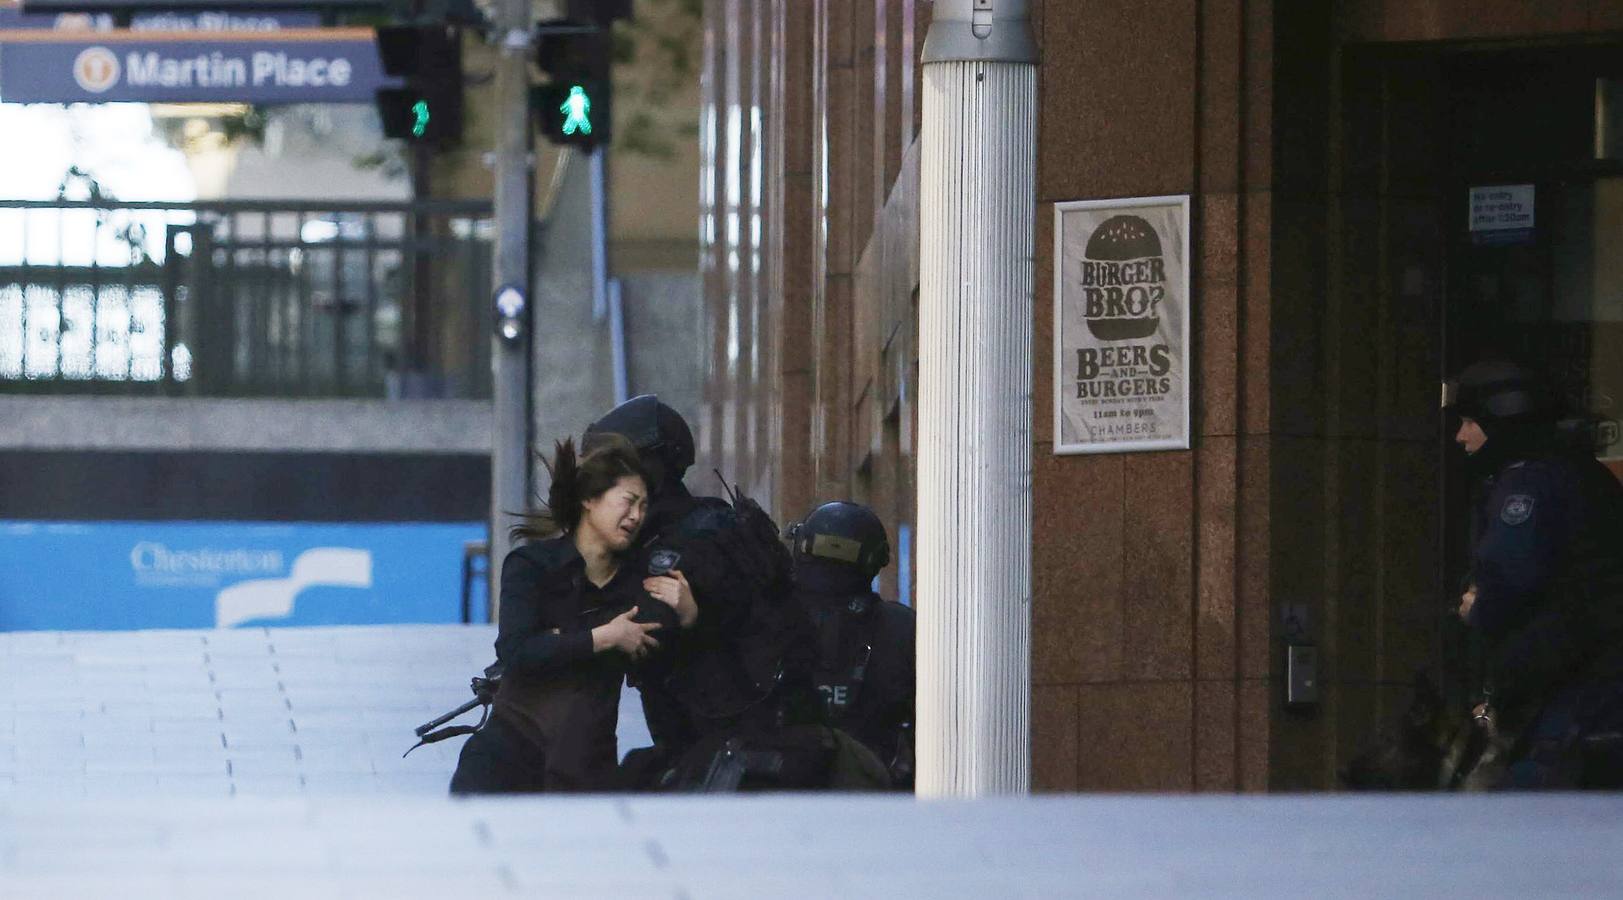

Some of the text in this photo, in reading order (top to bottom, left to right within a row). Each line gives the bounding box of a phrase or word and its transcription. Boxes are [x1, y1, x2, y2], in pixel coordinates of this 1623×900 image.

[125, 50, 246, 88] Martin
[252, 50, 352, 88] Place
[1473, 192, 1485, 201] No
[1081, 258, 1166, 287] BURGER
[1082, 286, 1165, 317] BRO?
[1077, 344, 1170, 380] BEERS
[1076, 378, 1170, 399] BURGERS
[1093, 408, 1155, 419] 11am to 9pm
[1090, 422, 1157, 437] CHAMBERS
[131, 541, 283, 574] Chesterton
